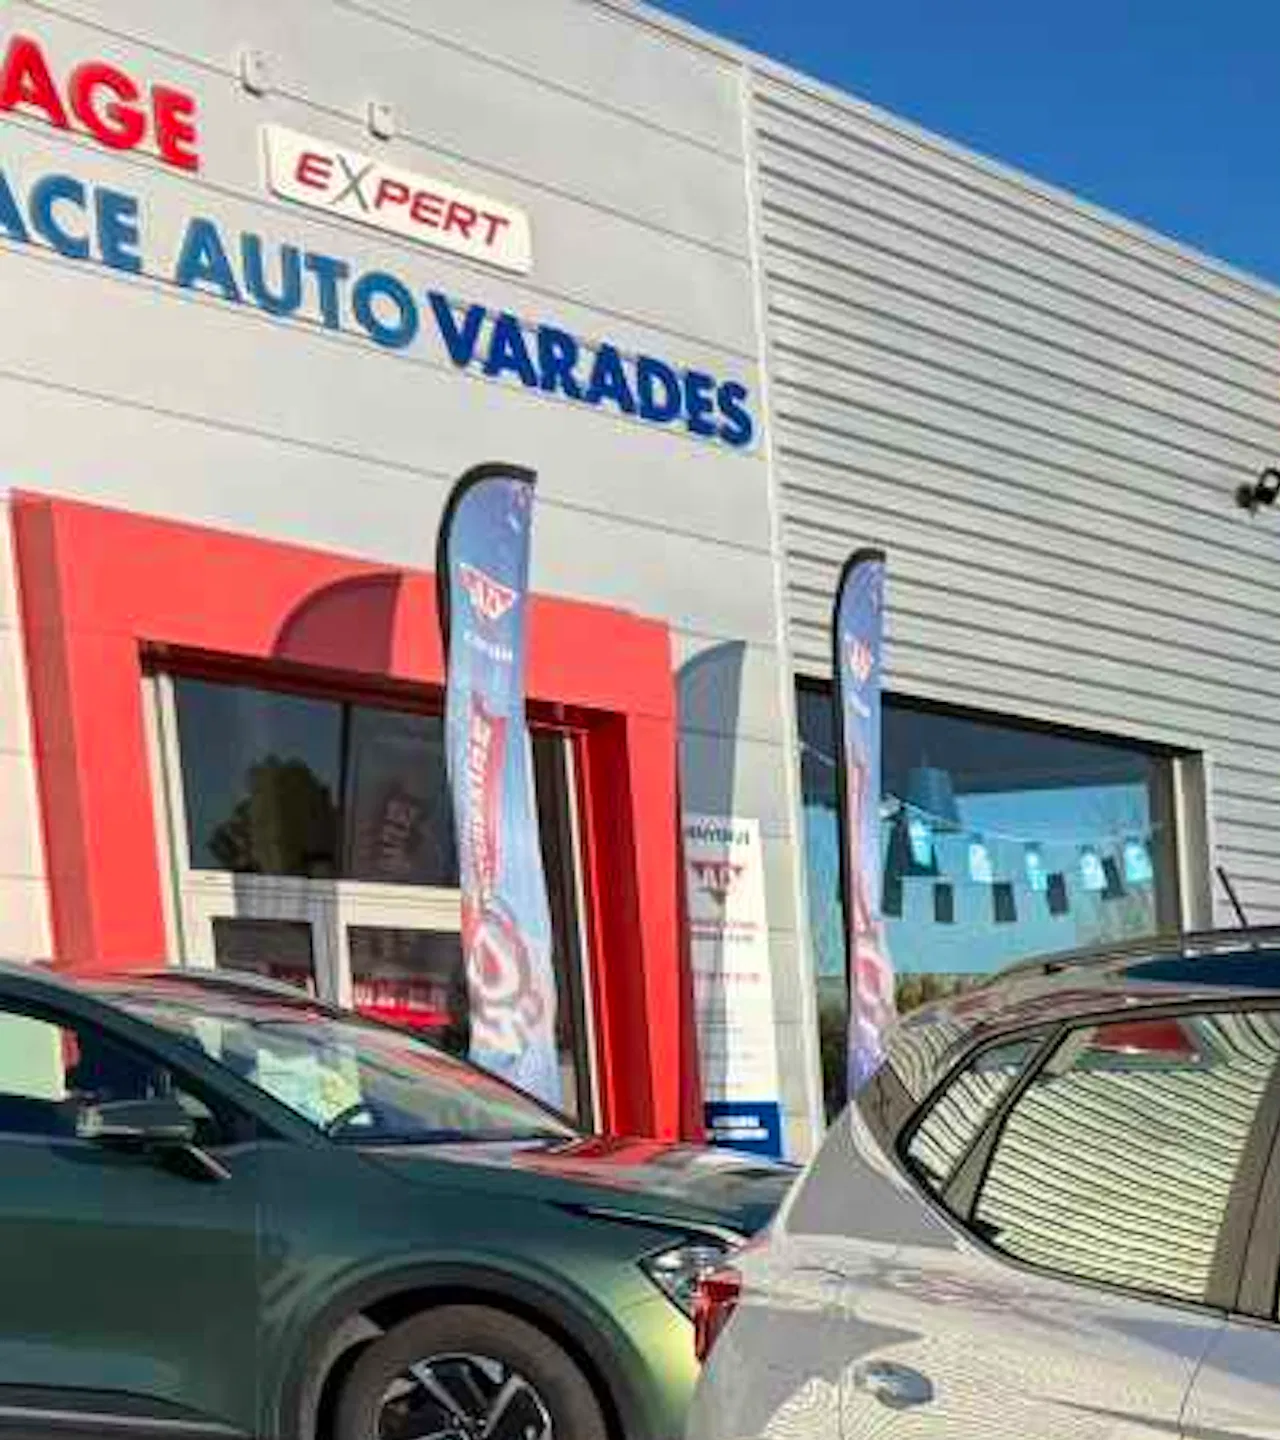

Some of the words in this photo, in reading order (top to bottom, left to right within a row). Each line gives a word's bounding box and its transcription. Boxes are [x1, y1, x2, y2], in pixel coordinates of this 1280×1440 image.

[0, 34, 198, 172] AGE
[295, 151, 512, 246] EXPERT
[176, 216, 419, 349] AUTO
[427, 289, 754, 448] VARADES
